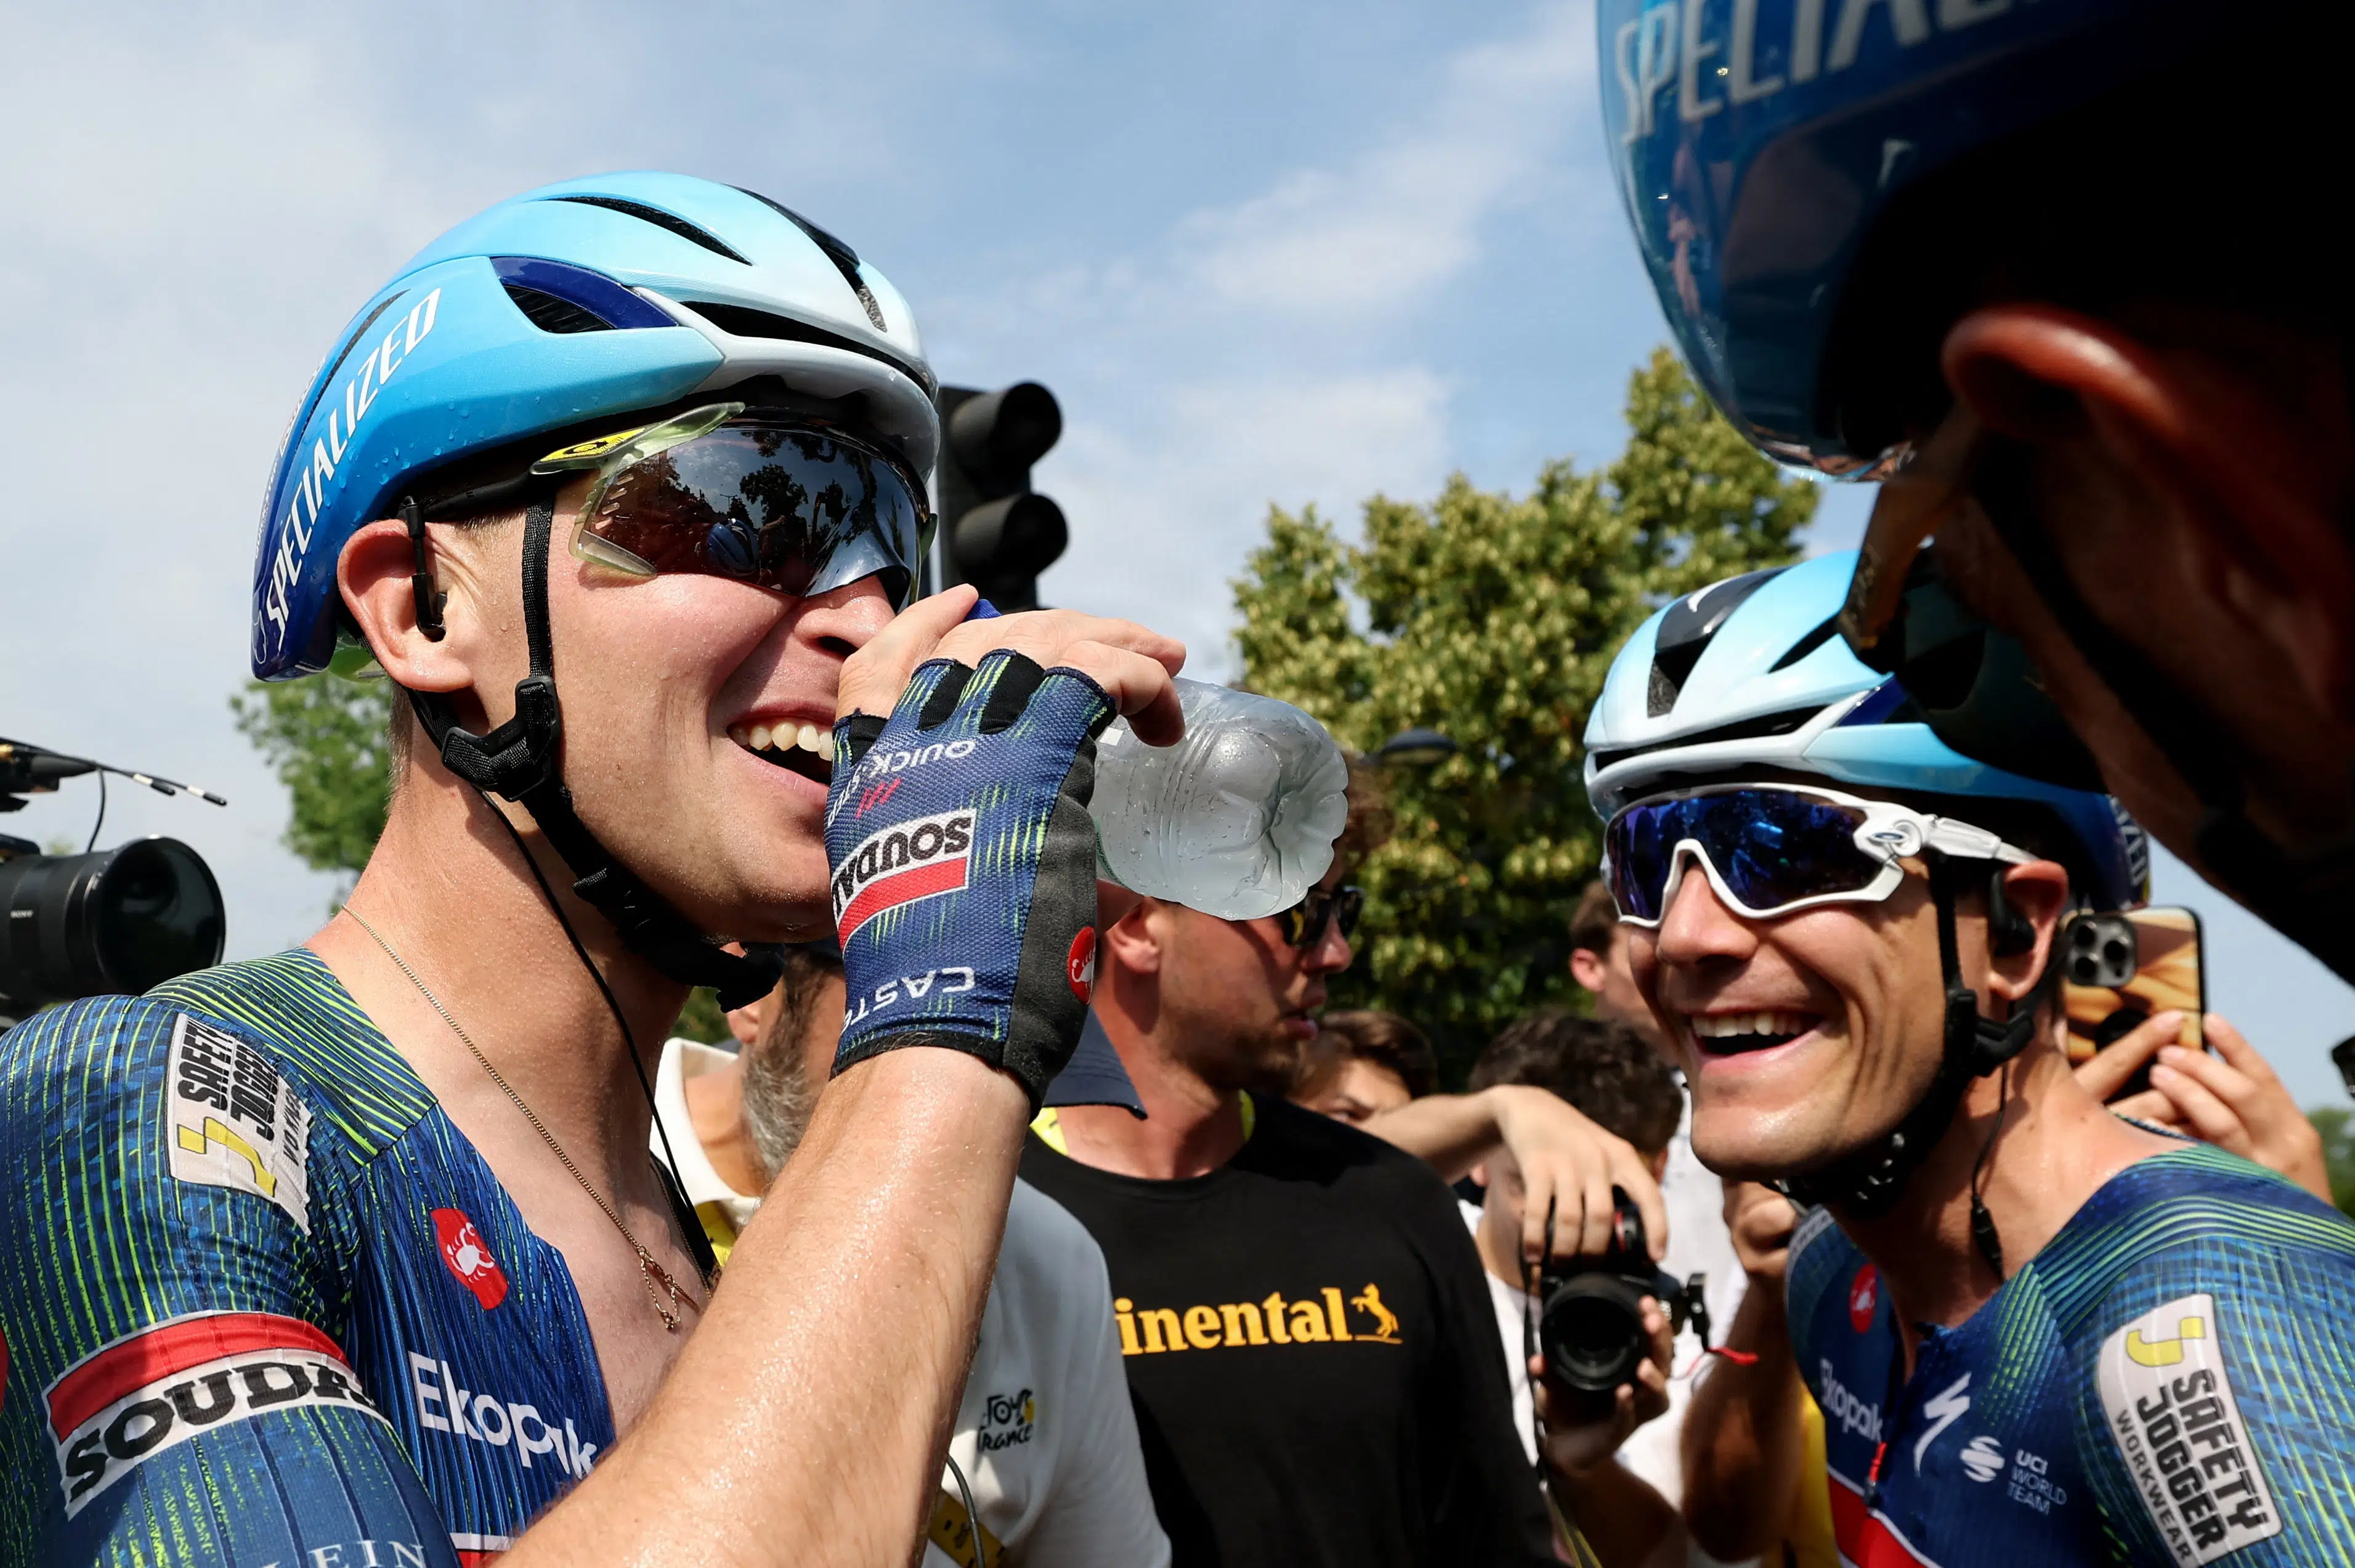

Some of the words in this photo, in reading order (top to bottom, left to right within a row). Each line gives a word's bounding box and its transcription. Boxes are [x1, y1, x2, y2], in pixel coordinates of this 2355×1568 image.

[266, 288, 441, 651] SPECIALIZED
[1114, 1287, 1353, 1355] inental
[1820, 1357, 1884, 1444] Ekopak
[2011, 1464, 2067, 1506] WORLD
[2015, 1448, 2048, 1476] UCI
[2116, 1409, 2192, 1560] WORKWEAR
[2137, 1384, 2229, 1551] JOGGER
[2173, 1368, 2271, 1530] SAFETY
[2006, 1480, 2051, 1516] TEAM
[261, 1539, 430, 1568] EIN
